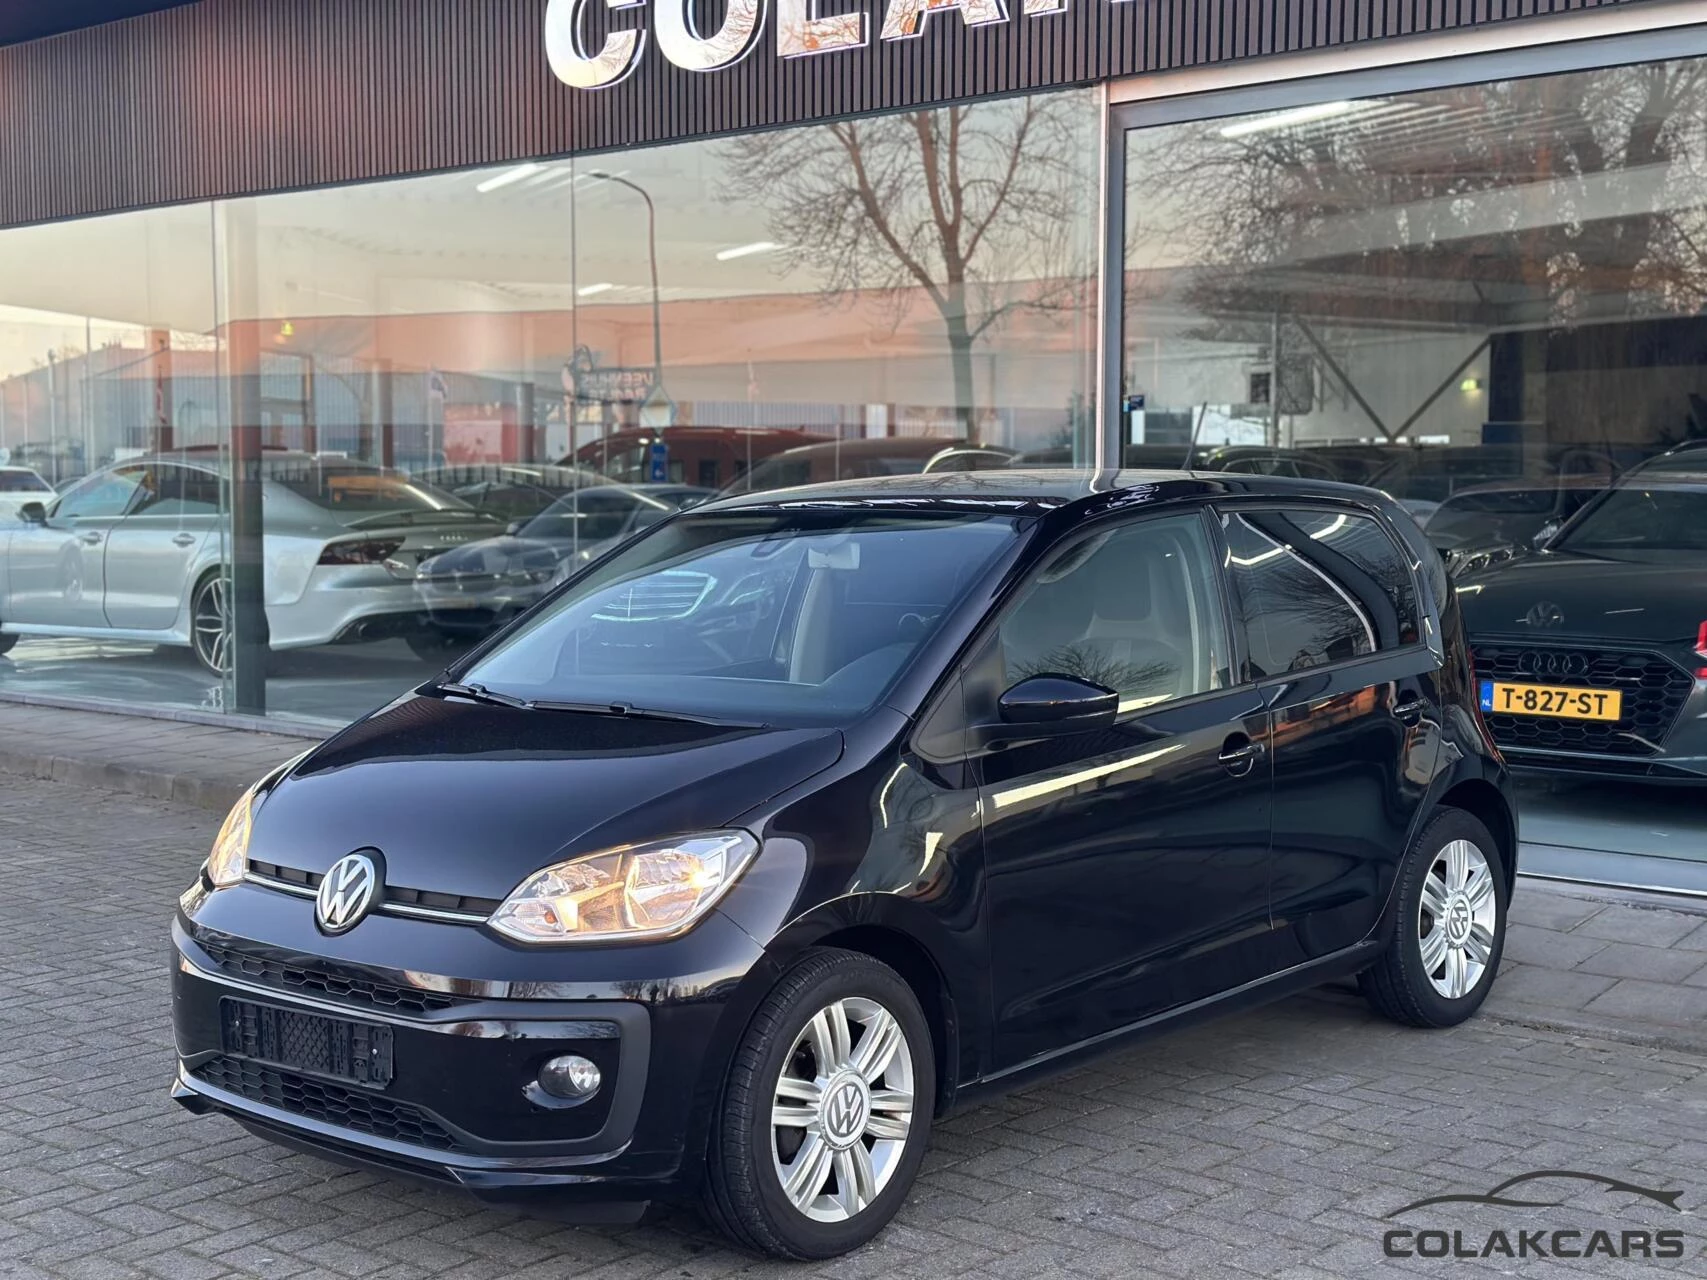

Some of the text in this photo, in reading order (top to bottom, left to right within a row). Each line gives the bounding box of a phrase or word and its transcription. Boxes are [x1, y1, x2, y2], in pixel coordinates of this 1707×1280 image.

[545, 0, 1067, 89] COL
[1482, 698, 1491, 706] NL
[1502, 687, 1608, 716] T-827-ST
[316, 853, 375, 930] VW
[828, 1082, 864, 1138] VW
